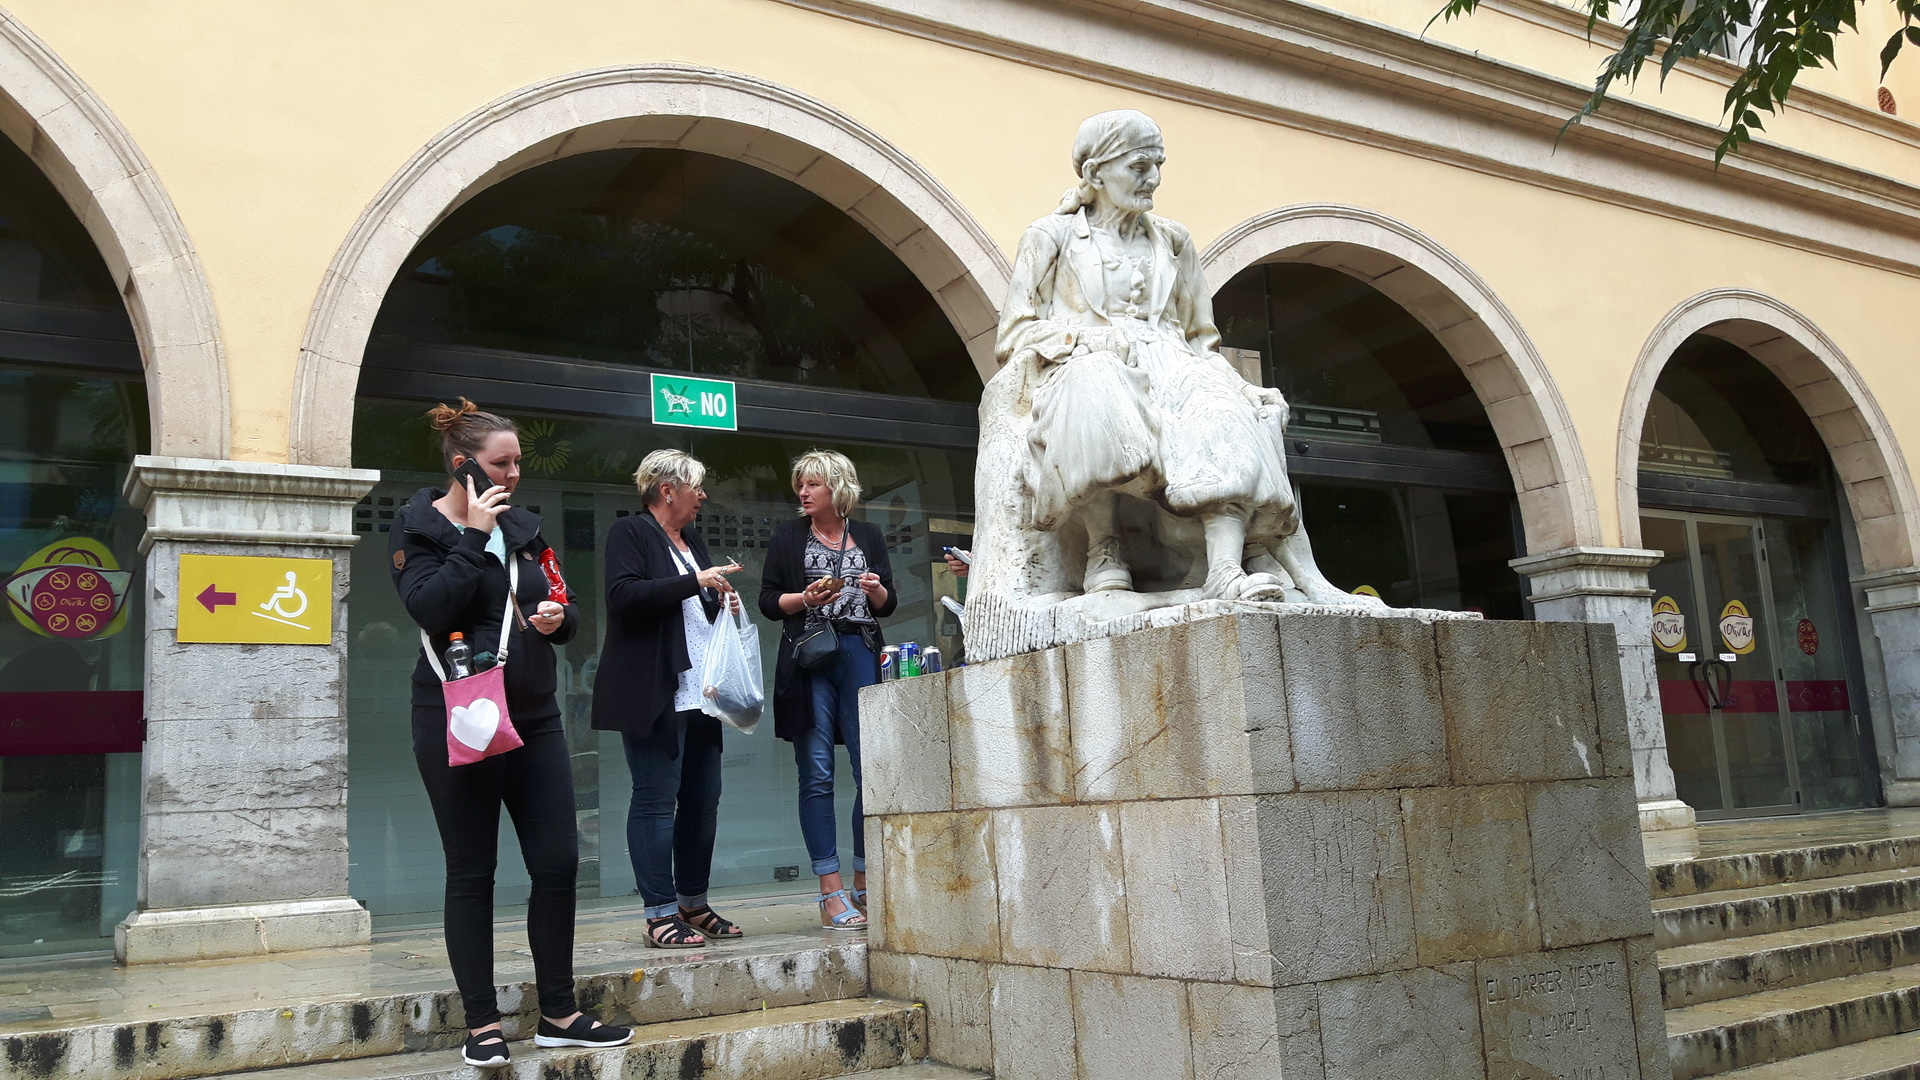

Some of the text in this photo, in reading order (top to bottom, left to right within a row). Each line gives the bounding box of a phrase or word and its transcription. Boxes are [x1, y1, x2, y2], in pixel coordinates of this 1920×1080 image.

[701, 392, 727, 417] NO
[1486, 978, 1506, 1005] EL
[1512, 970, 1564, 999] DARRER
